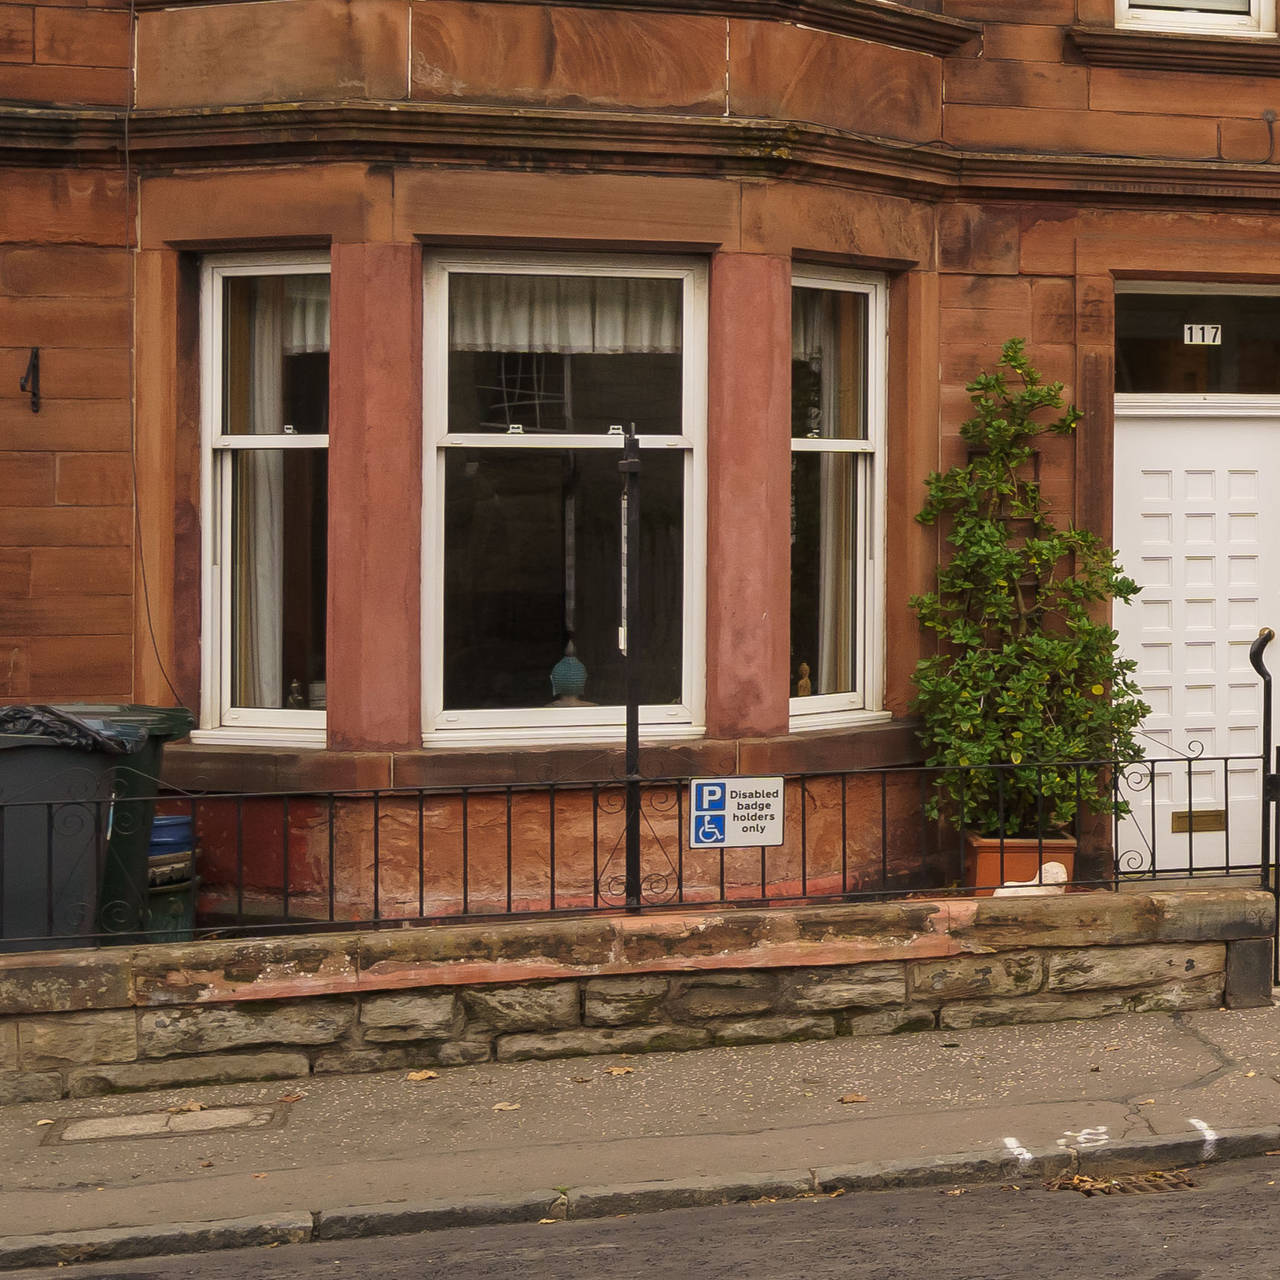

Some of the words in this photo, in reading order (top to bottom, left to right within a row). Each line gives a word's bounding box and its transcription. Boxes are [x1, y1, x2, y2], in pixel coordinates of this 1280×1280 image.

[1187, 325, 1220, 343] 117
[702, 786, 722, 809] P
[730, 789, 779, 800] Disabled
[736, 801, 772, 811] badge
[732, 813, 776, 822] holders
[741, 823, 766, 834] only
